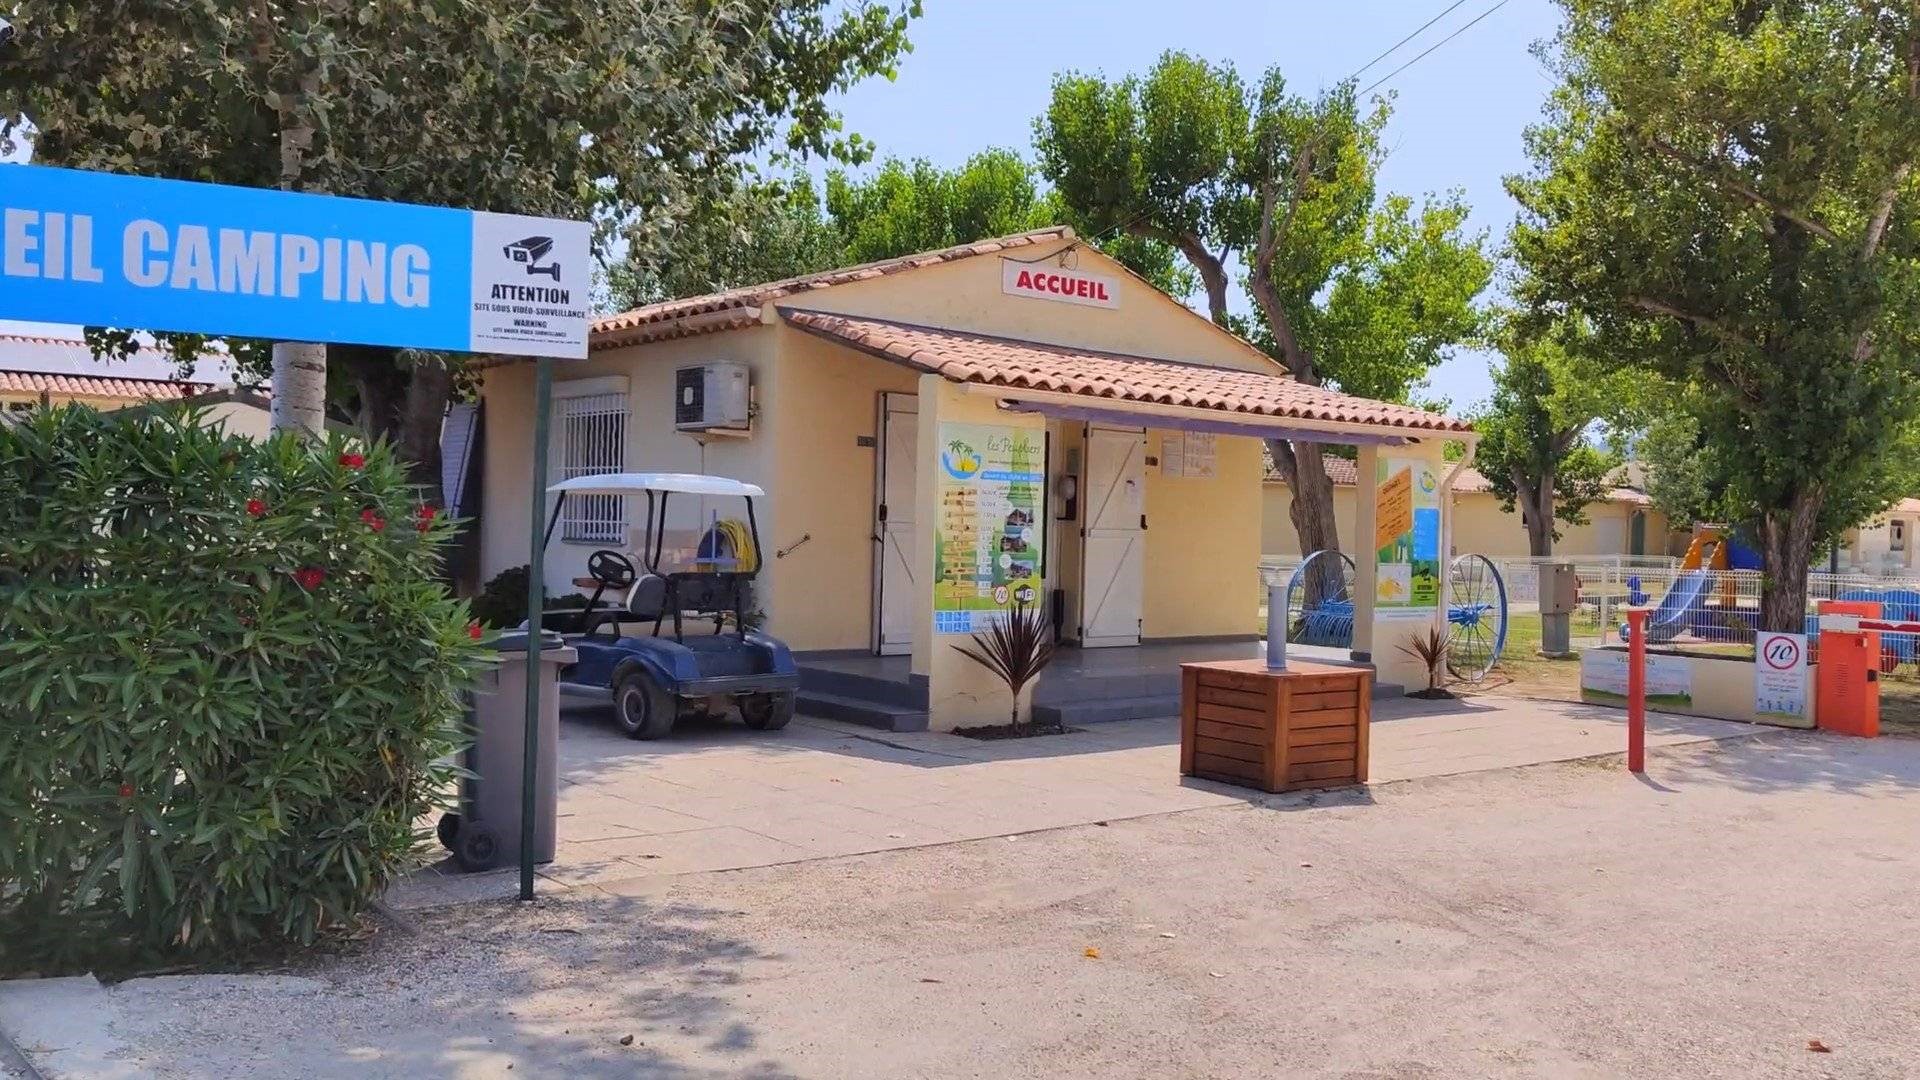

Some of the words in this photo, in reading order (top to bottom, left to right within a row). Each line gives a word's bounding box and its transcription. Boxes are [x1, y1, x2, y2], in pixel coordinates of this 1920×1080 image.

[4, 208, 104, 283] EIL
[122, 218, 431, 309] CAMPING
[491, 283, 570, 305] ATTENTION
[1016, 270, 1109, 301] ACCUEIL
[474, 303, 490, 312] SITE
[491, 304, 511, 314] SOUS
[513, 319, 548, 329] WARNING
[1769, 645, 1793, 660] 10
